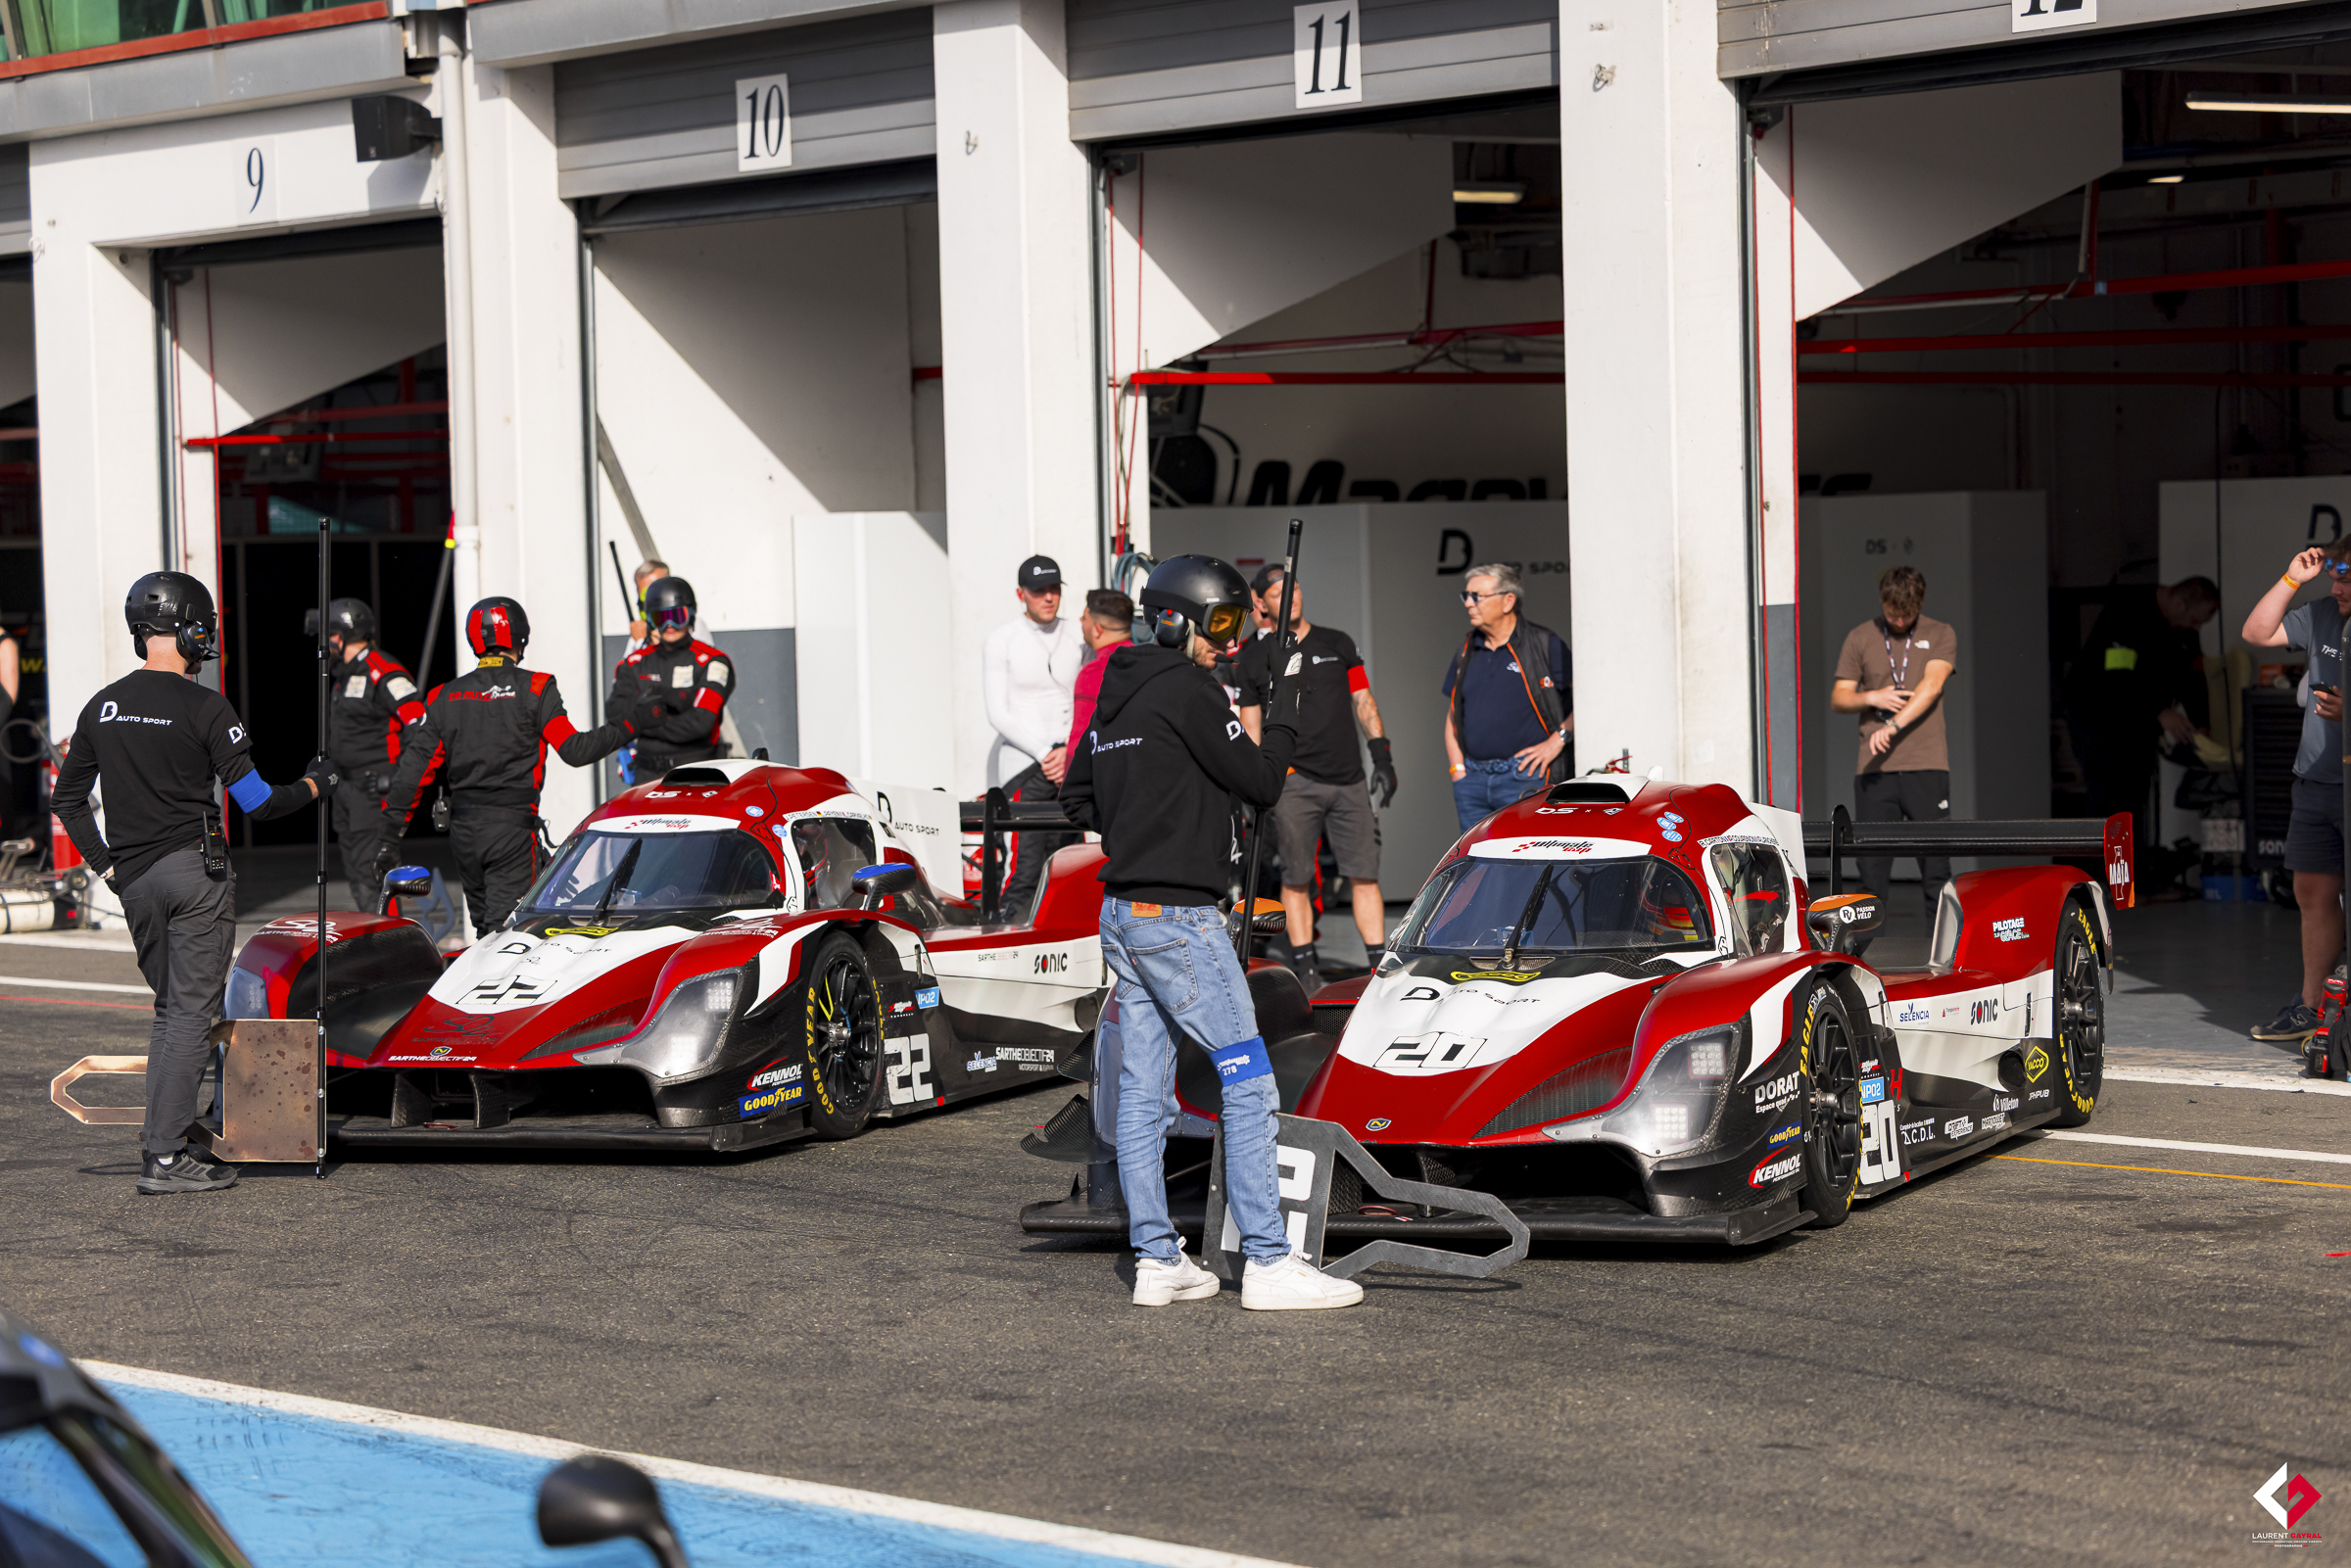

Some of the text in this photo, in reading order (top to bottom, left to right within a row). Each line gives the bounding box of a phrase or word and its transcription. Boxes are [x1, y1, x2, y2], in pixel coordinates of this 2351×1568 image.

[1305, 10, 1352, 94] 11
[744, 84, 786, 159] 10
[247, 148, 264, 213] 9
[1529, 561, 1569, 575] SPO
[142, 717, 173, 726] SPORT
[1097, 743, 1114, 753] AUTO
[1115, 737, 1143, 748] SPORT
[895, 822, 913, 832] AUTO
[916, 825, 939, 836] SPORT
[1992, 917, 2025, 931] PILOTAGE
[2078, 907, 2097, 955] EAGLE
[1034, 953, 1068, 974] SONIC
[454, 974, 559, 1005] 22
[1970, 997, 1998, 1025] SONIC
[1372, 1030, 1488, 1069] 20
[1799, 1005, 1815, 1077] EAGLE
[751, 1064, 803, 1088] KENNOL
[884, 1033, 934, 1106] 22
[744, 1086, 802, 1112] GOODYEAR
[1755, 1070, 1799, 1104] DORAT
[1769, 1126, 1800, 1142] GOODYEAR
[1860, 1099, 1901, 1186] 20
[1753, 1153, 1801, 1184] KENNOL
